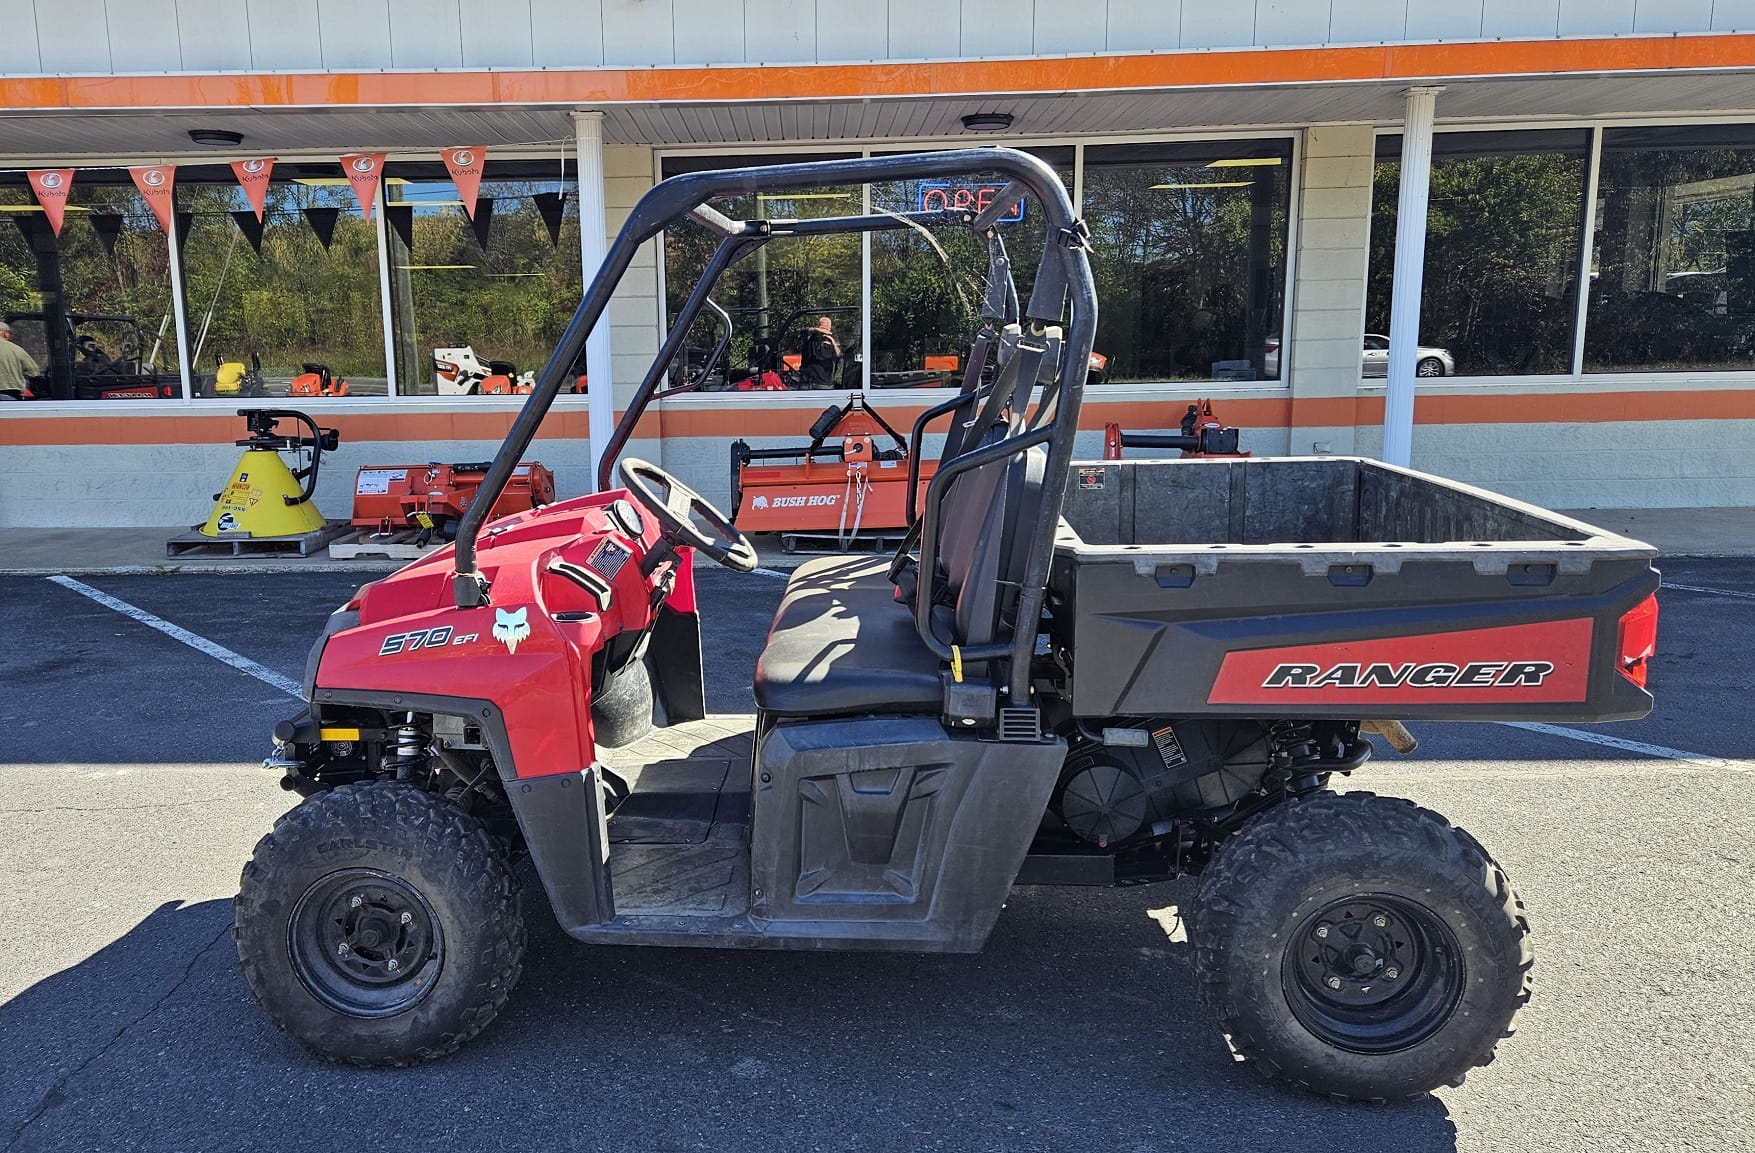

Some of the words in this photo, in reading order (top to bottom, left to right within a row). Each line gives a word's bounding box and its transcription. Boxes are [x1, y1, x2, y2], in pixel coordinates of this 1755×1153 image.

[452, 168, 480, 176] Kubota
[242, 174, 269, 184] Kubota
[352, 174, 378, 182] Kubota
[38, 190, 67, 198] Kubota
[142, 188, 171, 196] Kubota
[924, 189, 1018, 216] OPE
[771, 496, 807, 508] BUSH
[378, 625, 454, 656] 570
[452, 633, 480, 646] EFI
[1262, 661, 1554, 688] RANGER
